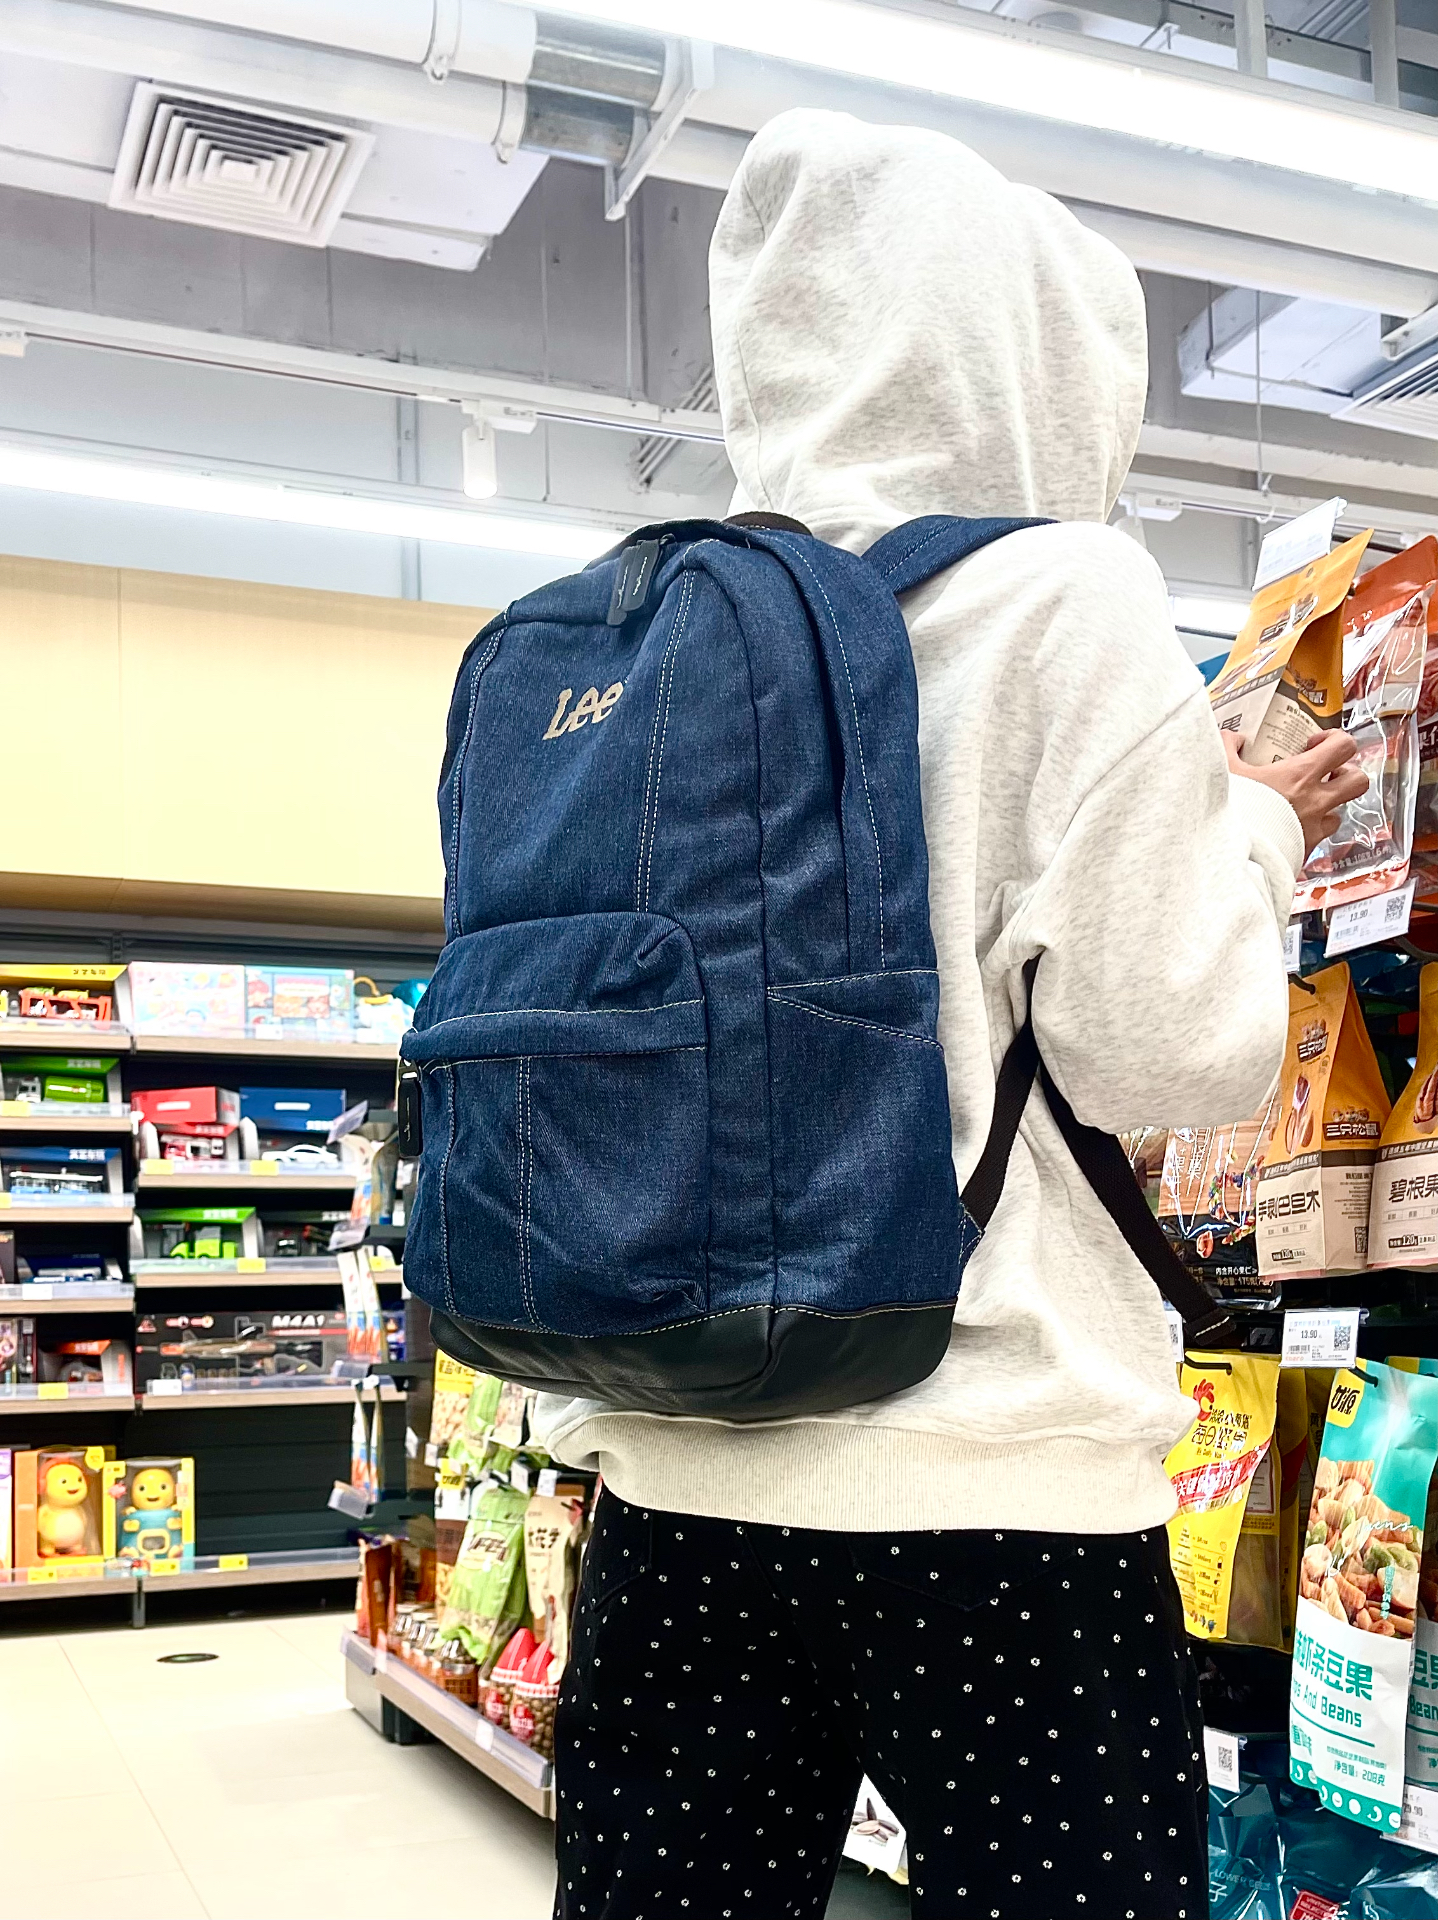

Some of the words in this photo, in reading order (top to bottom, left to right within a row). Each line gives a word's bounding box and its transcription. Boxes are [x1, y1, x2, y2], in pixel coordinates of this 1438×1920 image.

[542, 681, 624, 741] Lee
[1349, 908, 1369, 923] 13.90
[1325, 1122, 1379, 1138] 三只松鼠
[1388, 1174, 1438, 1204] 碧根果
[1257, 1189, 1321, 1222] 手剥巴旦木
[272, 1314, 325, 1327] M4A1
[1301, 1329, 1318, 1340] 13.90
[1303, 1684, 1317, 1710] And
[1320, 1695, 1363, 1728] Beans
[1362, 1769, 1386, 1787] 208克
